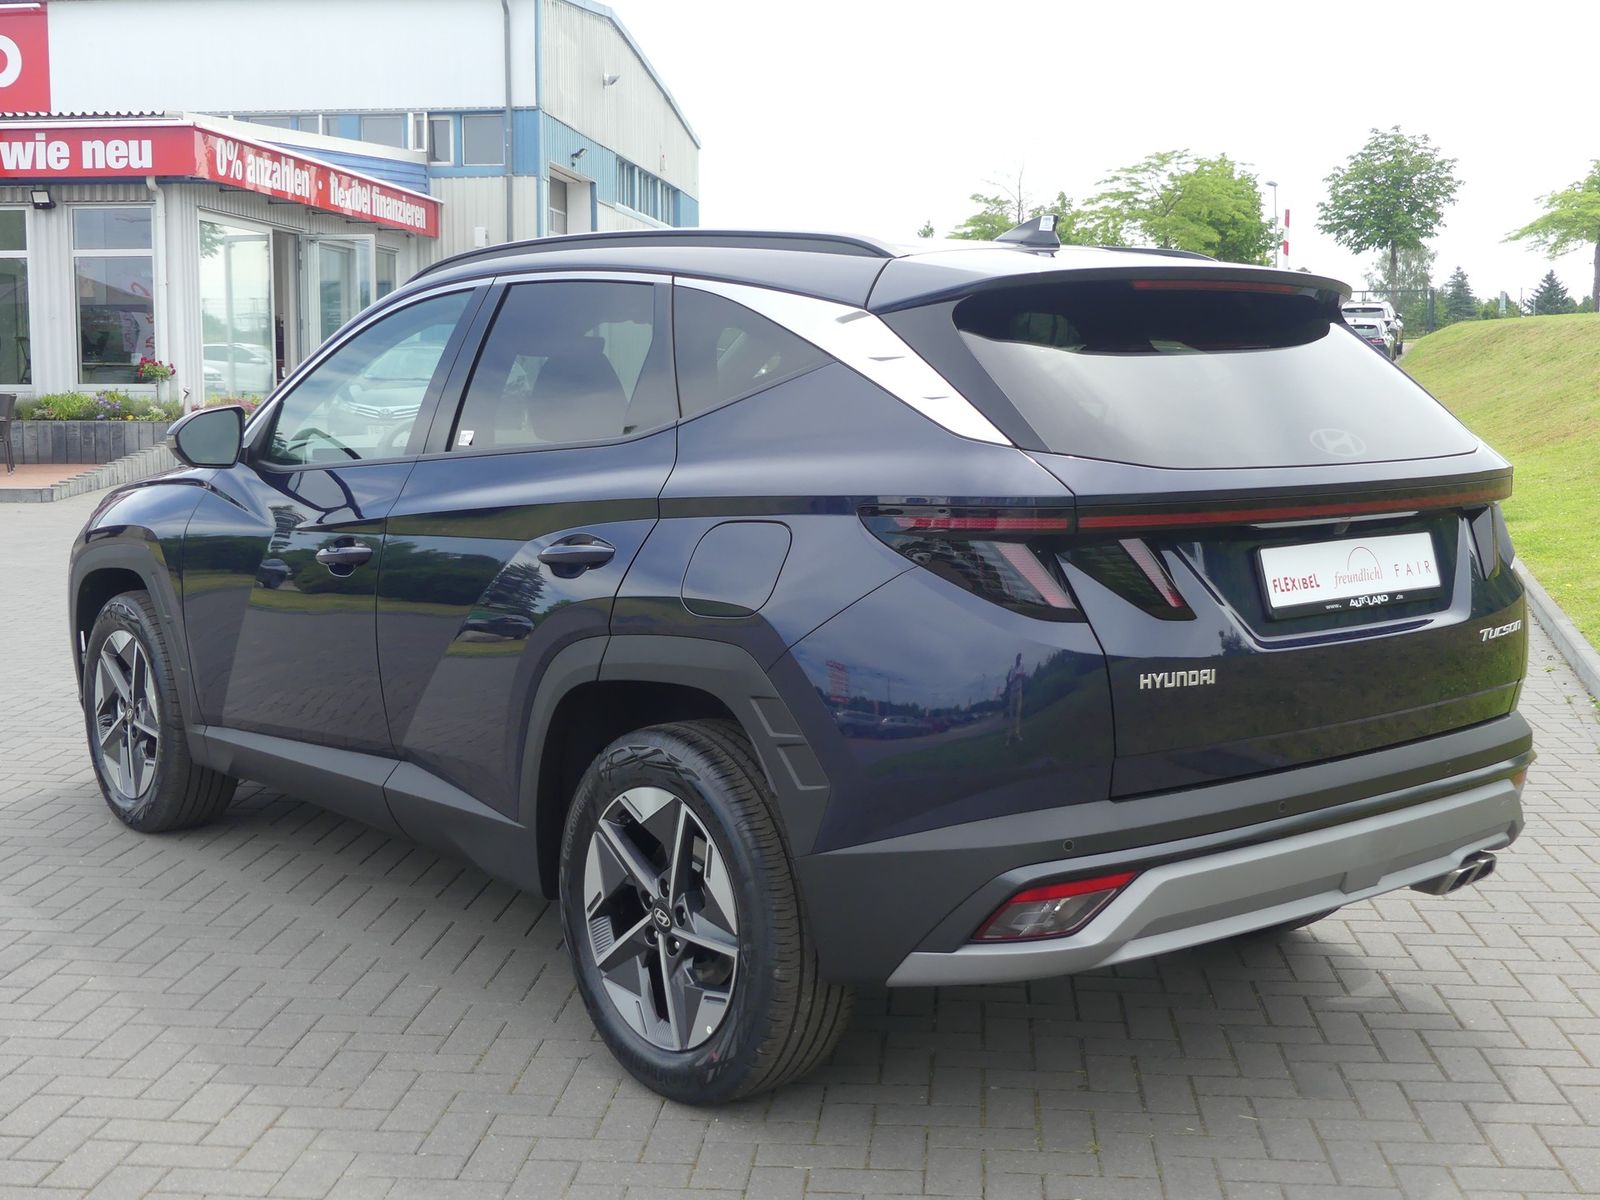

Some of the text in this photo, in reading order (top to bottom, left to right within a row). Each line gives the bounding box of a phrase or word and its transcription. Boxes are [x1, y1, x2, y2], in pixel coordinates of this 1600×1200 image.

[1, 133, 153, 170] wie neu
[216, 138, 426, 229] 0% anzahlen flexibel finanzieren
[1272, 573, 1320, 593] FLEXIBEL
[1334, 567, 1380, 589] freundlich
[1349, 594, 1389, 608] AUTOLAND
[1140, 669, 1216, 690] HYUNDAI
